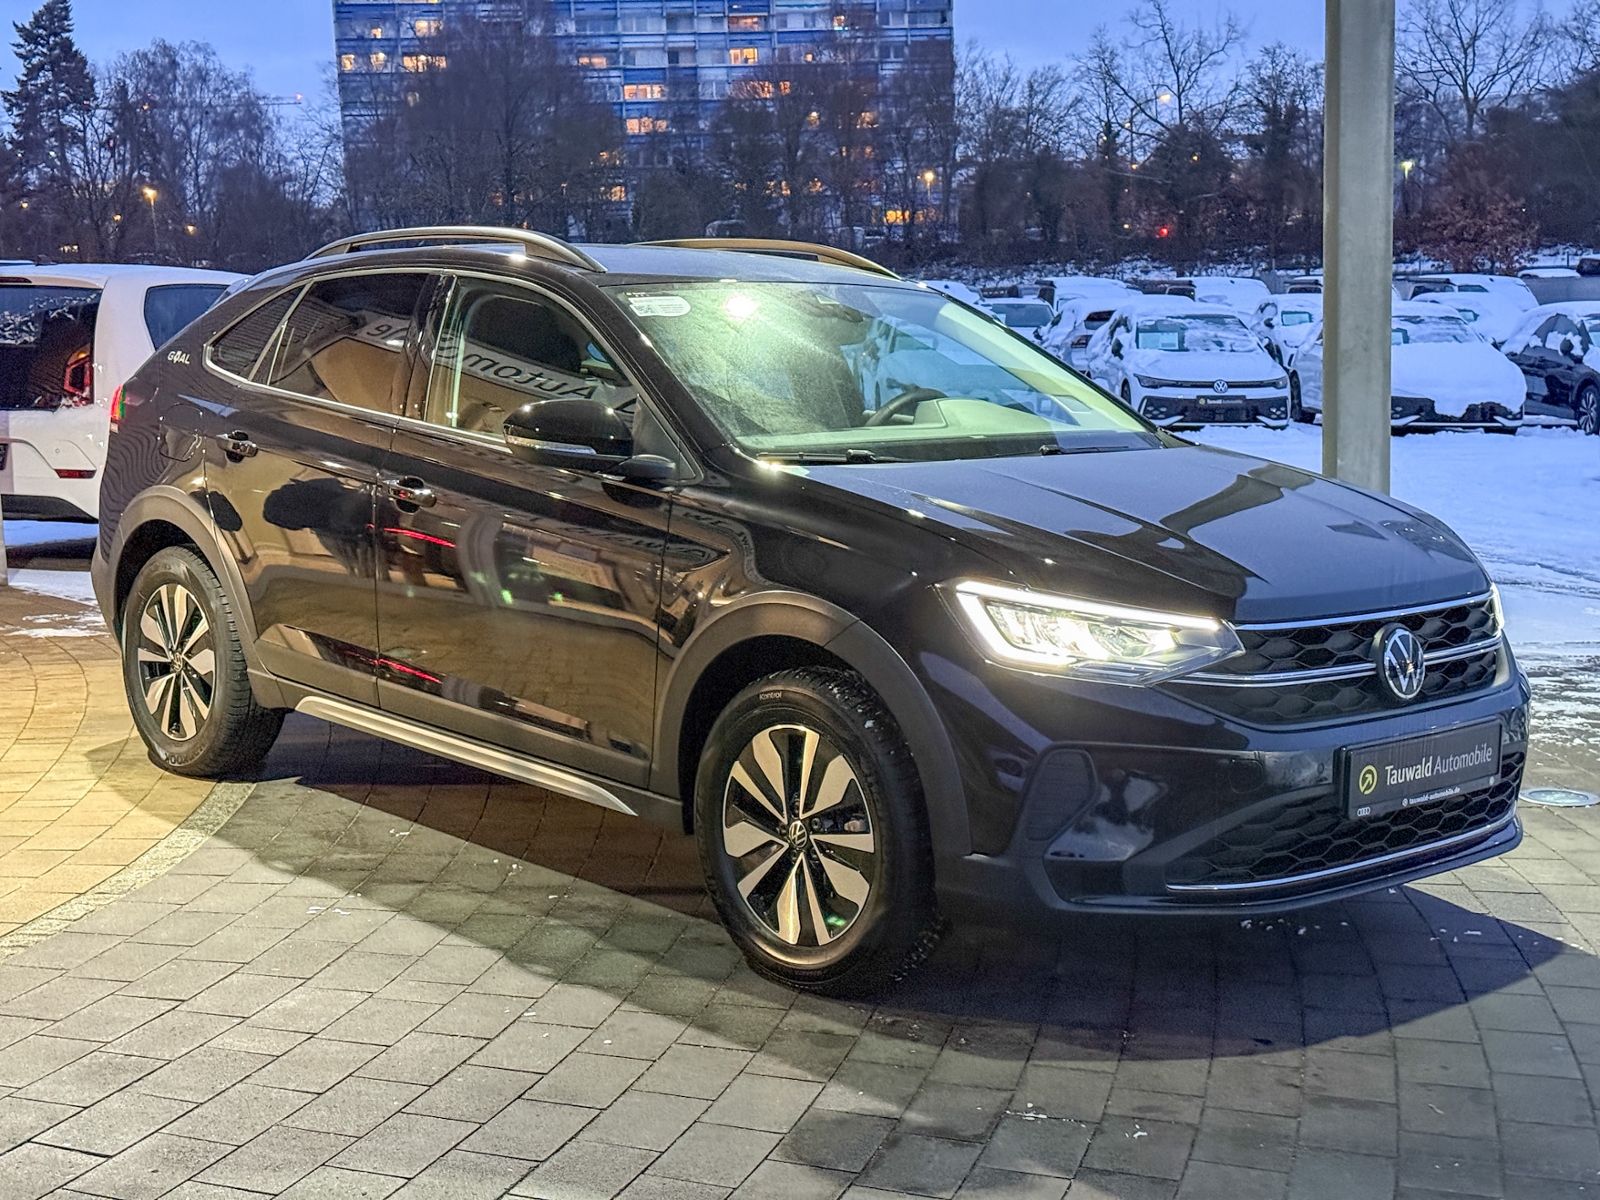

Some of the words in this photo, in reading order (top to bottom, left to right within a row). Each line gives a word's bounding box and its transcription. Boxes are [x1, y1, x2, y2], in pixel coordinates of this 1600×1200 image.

[167, 350, 190, 365] GOAL
[1385, 756, 1433, 786] Tauwald
[1433, 743, 1493, 775] Automobile
